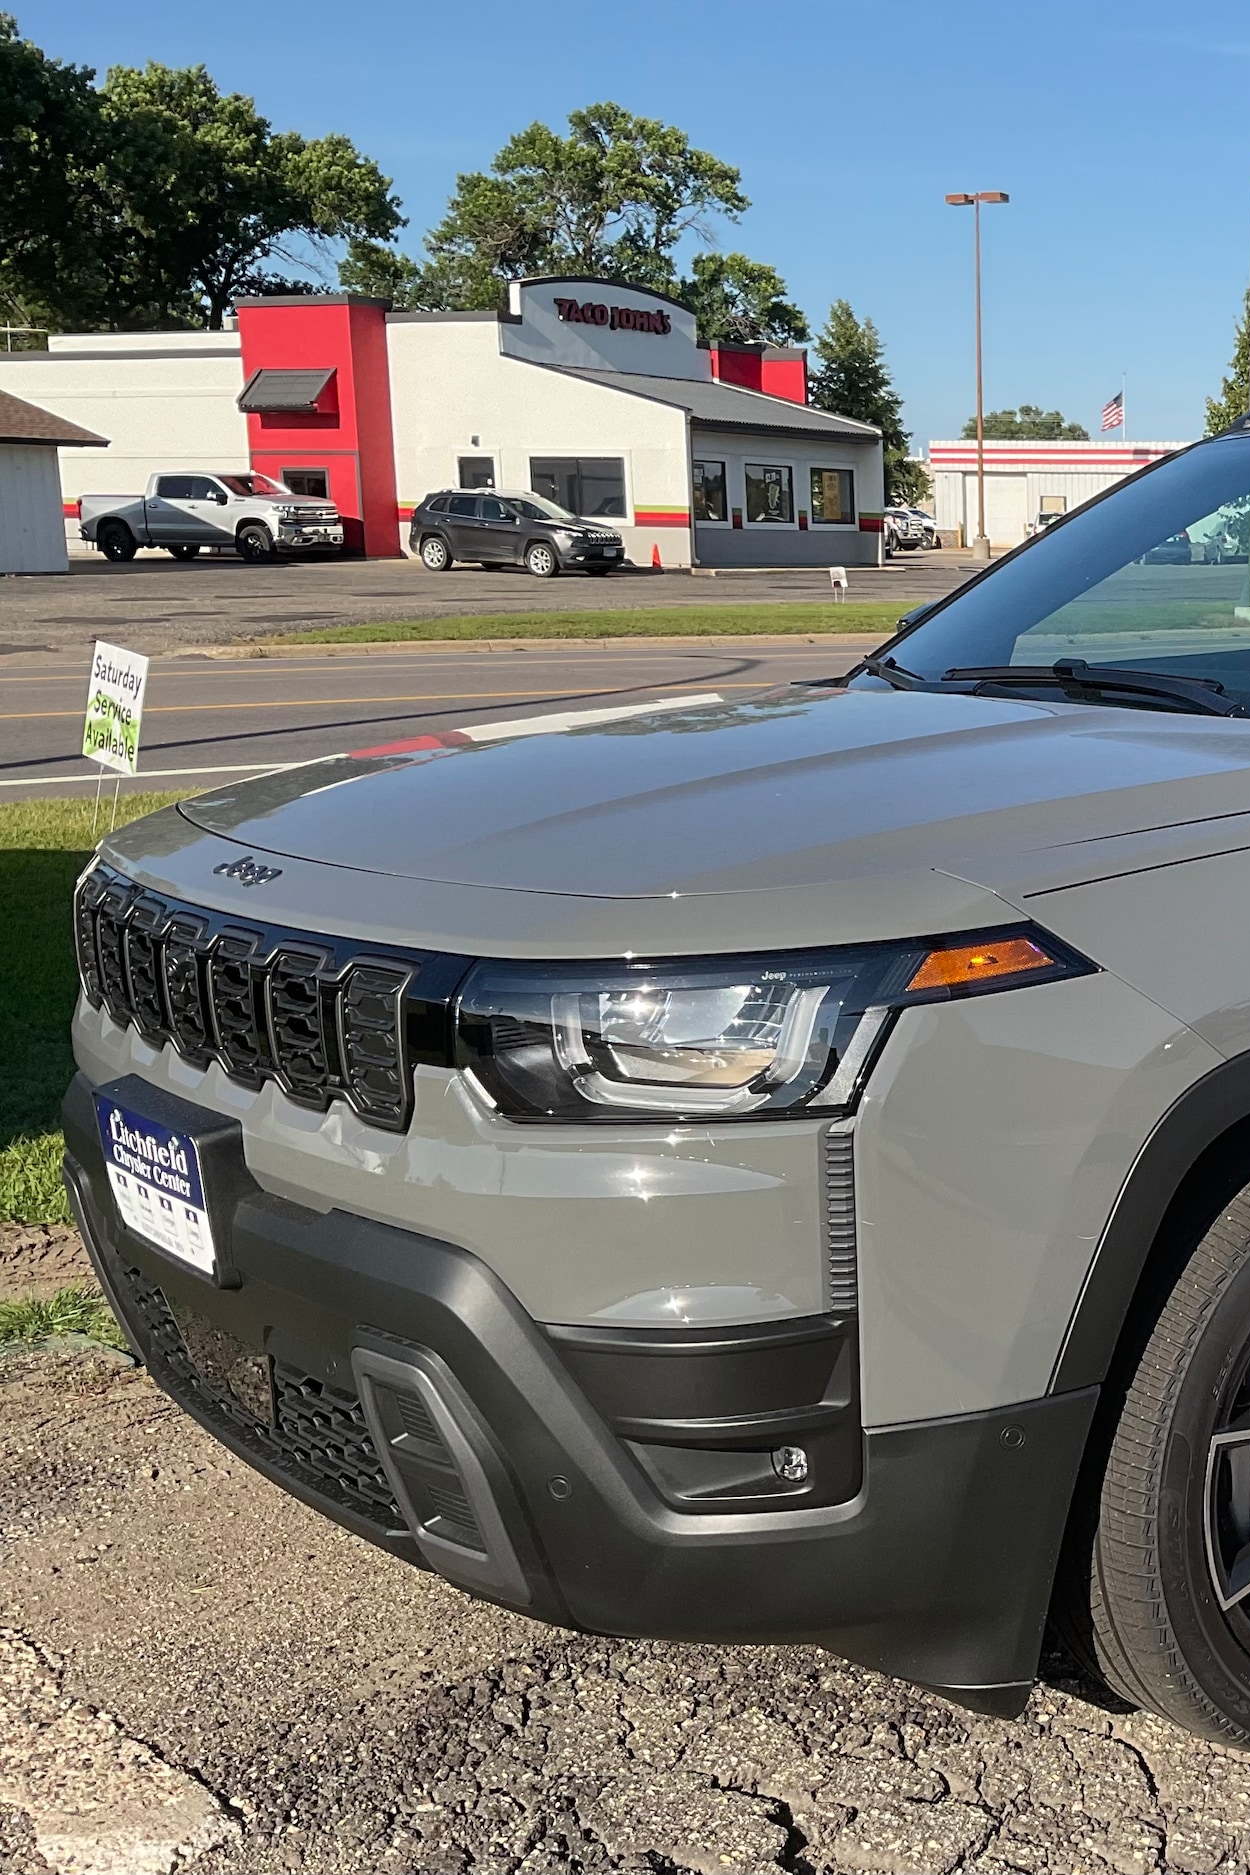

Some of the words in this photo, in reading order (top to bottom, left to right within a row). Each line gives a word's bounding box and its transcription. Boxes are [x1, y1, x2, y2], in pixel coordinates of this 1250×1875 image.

[553, 298, 609, 325] TACO
[609, 307, 671, 335] JOHN'S
[94, 654, 142, 700] Saturday
[94, 689, 132, 726] Service
[85, 720, 135, 762] Available
[213, 855, 283, 887] Jeep
[761, 970, 787, 981] Jeep
[109, 1108, 189, 1176] Litchfield
[113, 1144, 152, 1180] Chrysler
[152, 1166, 191, 1198] Center
